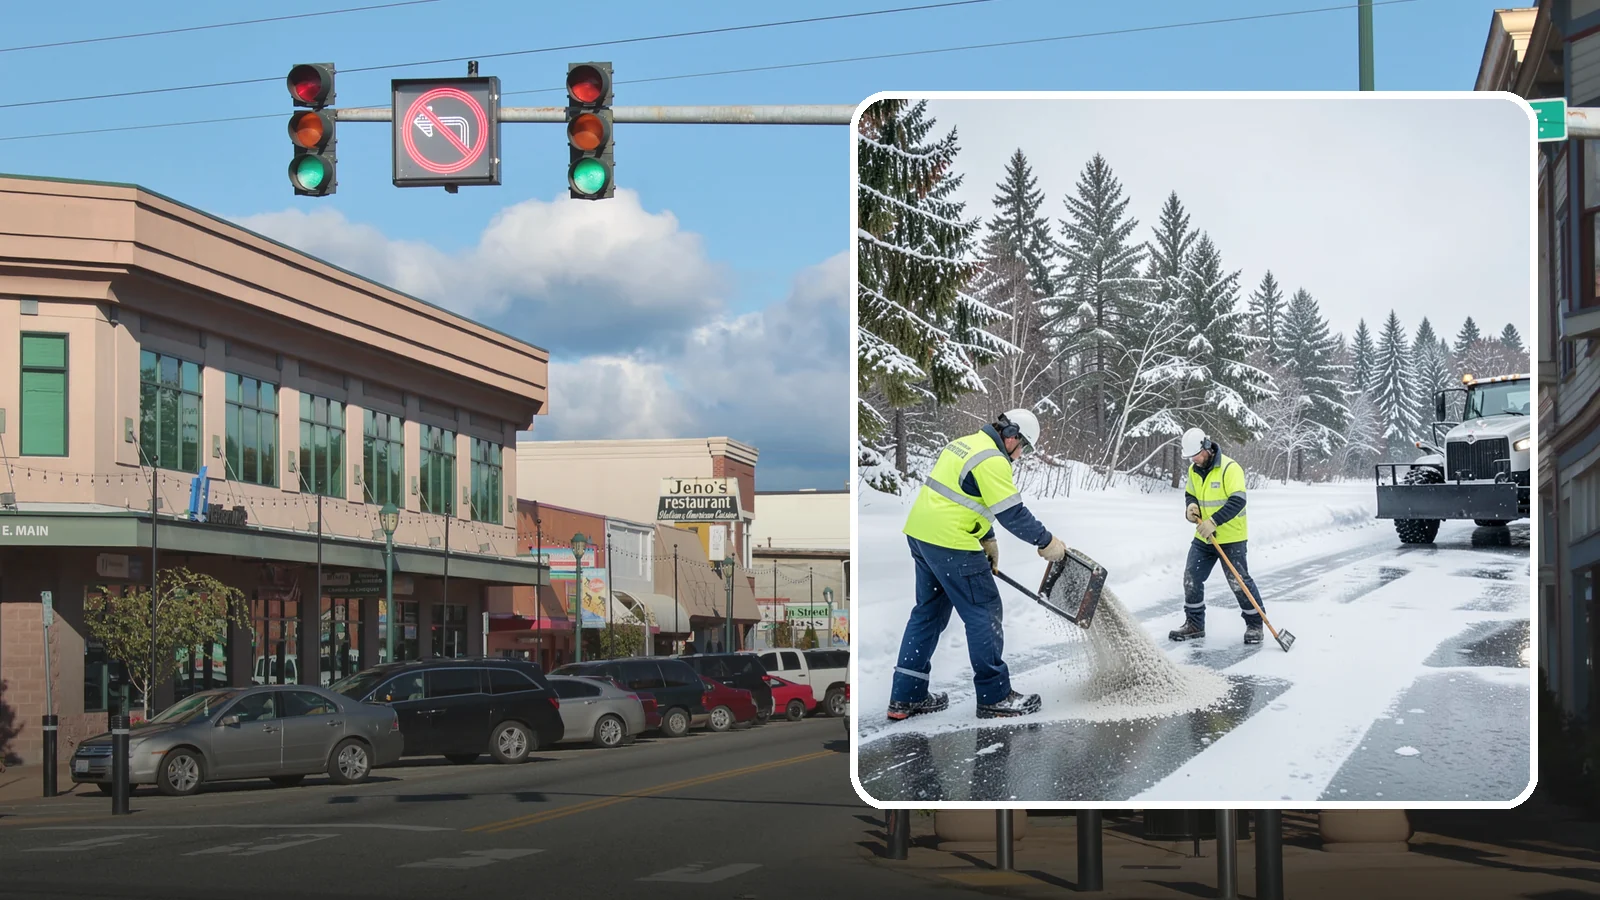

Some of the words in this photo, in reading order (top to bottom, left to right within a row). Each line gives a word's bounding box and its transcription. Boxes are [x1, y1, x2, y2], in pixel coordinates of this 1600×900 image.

[670, 480, 727, 494] Jeno's
[665, 496, 731, 509] restaurant
[658, 510, 682, 519] Italian
[686, 510, 715, 519] American
[715, 510, 738, 519] Cuisine
[2, 525, 13, 536] E.
[15, 525, 49, 536] MAIN
[797, 607, 828, 617] Street
[790, 619, 823, 627] lass
